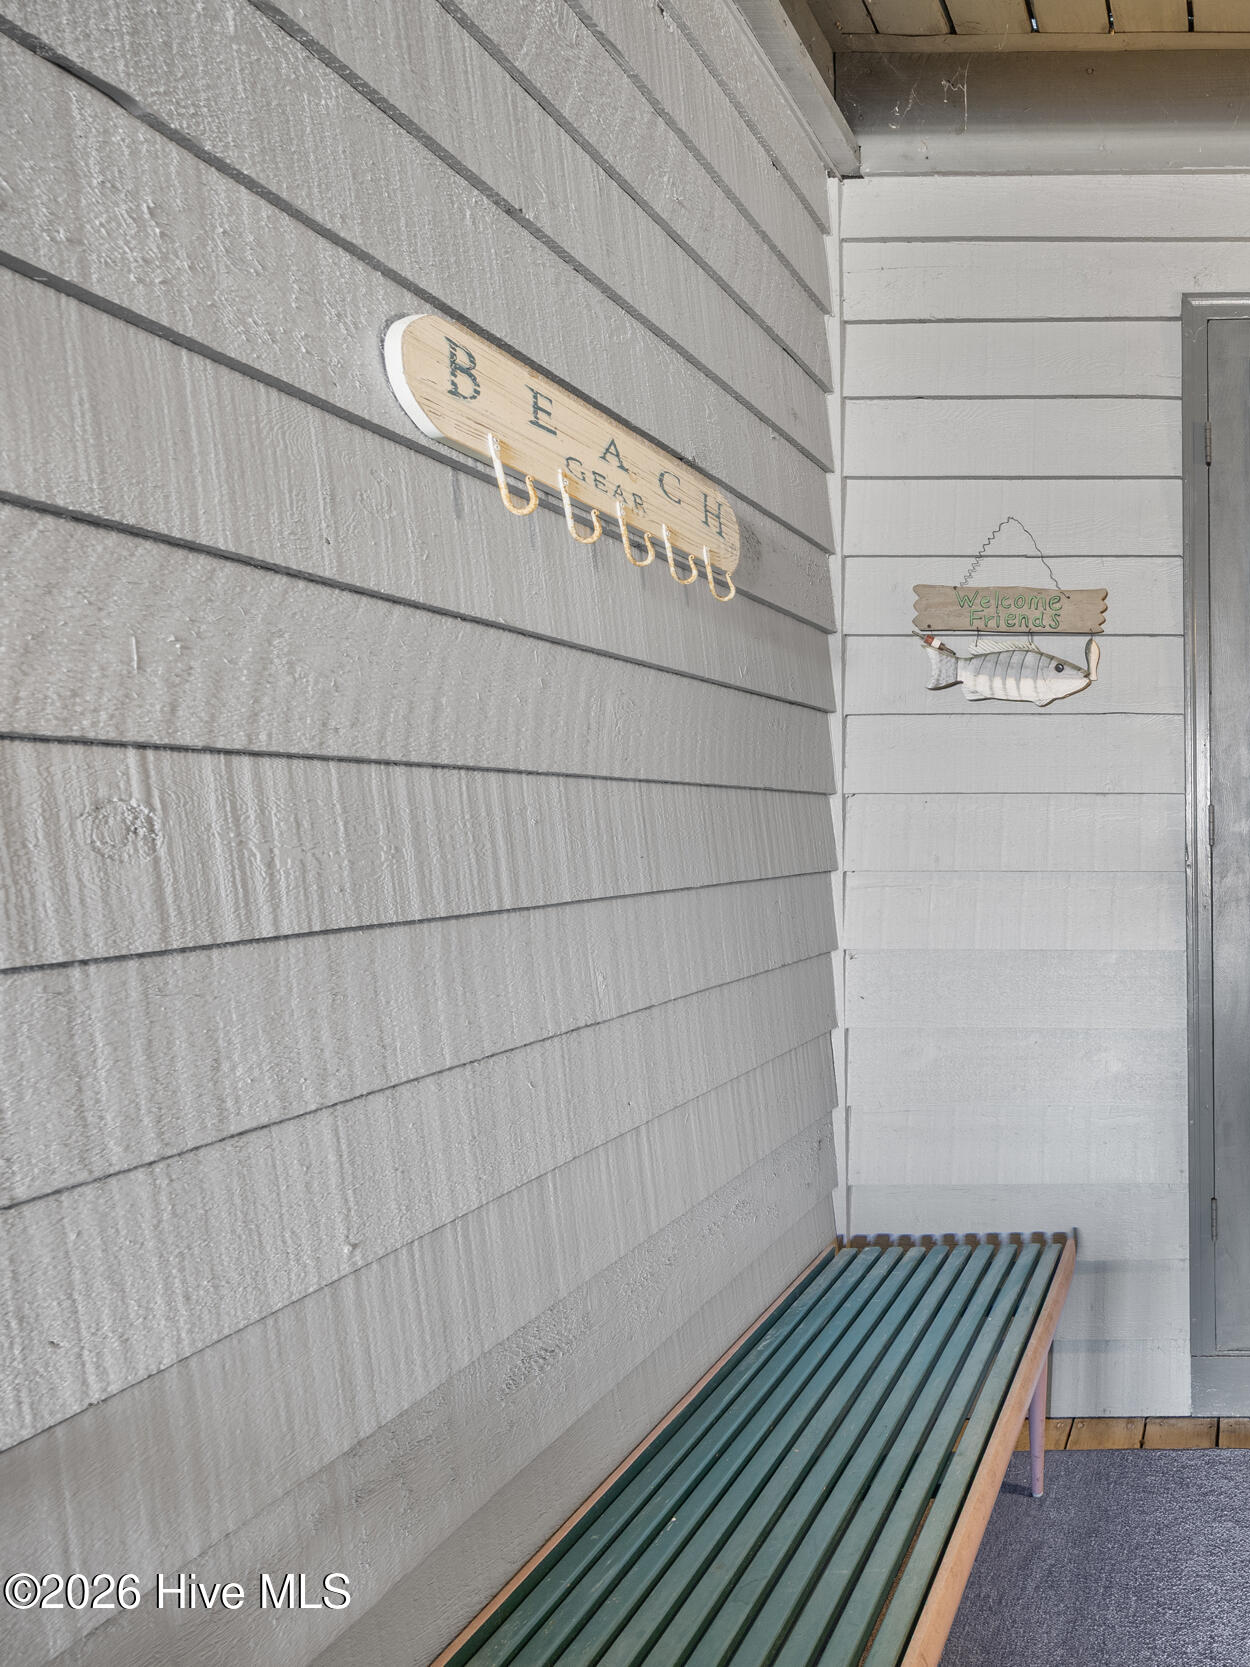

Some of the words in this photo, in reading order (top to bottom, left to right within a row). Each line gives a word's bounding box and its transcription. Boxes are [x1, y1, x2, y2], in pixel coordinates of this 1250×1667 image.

[444, 335, 726, 539] BEACH
[565, 456, 646, 515] GEAR
[955, 590, 1063, 611] Welcome
[969, 609, 1061, 629] Friends
